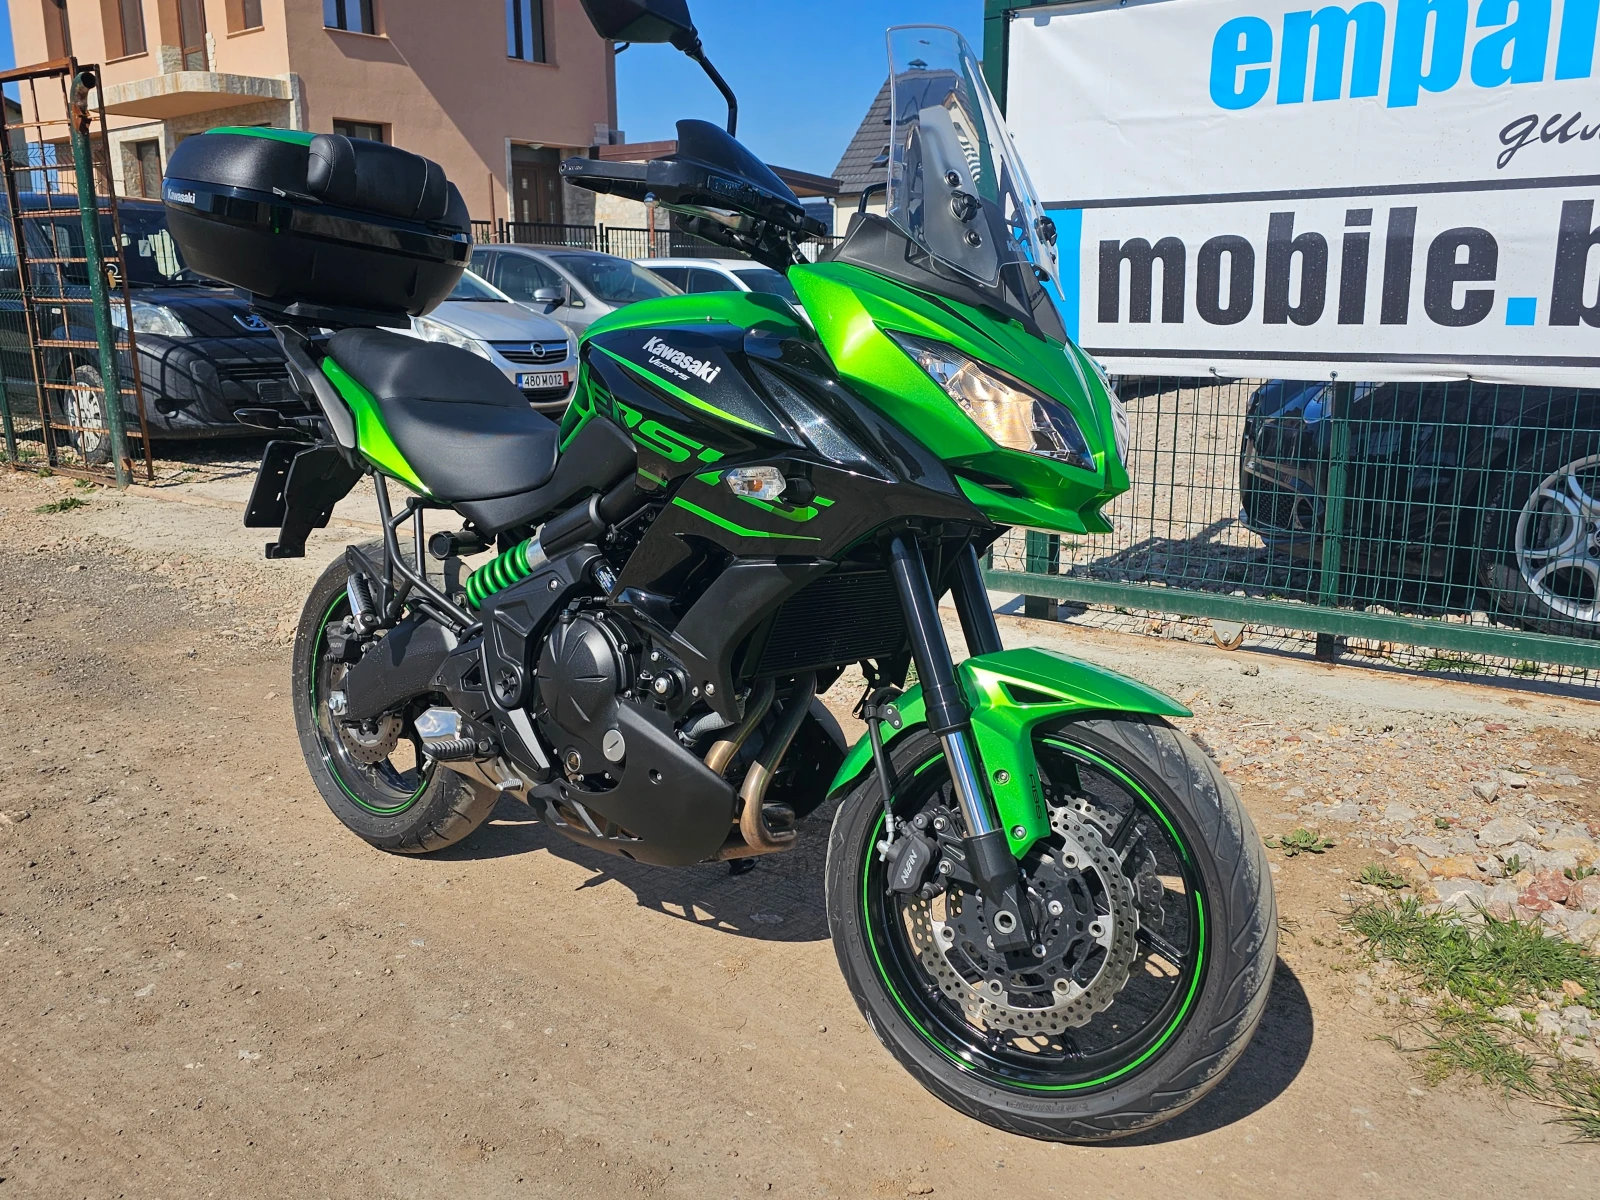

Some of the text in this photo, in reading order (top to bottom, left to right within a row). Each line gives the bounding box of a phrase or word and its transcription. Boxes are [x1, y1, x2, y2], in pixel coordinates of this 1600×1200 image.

[167, 188, 196, 204] Kawasaki
[642, 336, 721, 384] Kawasaki
[648, 355, 690, 380] VERSYS
